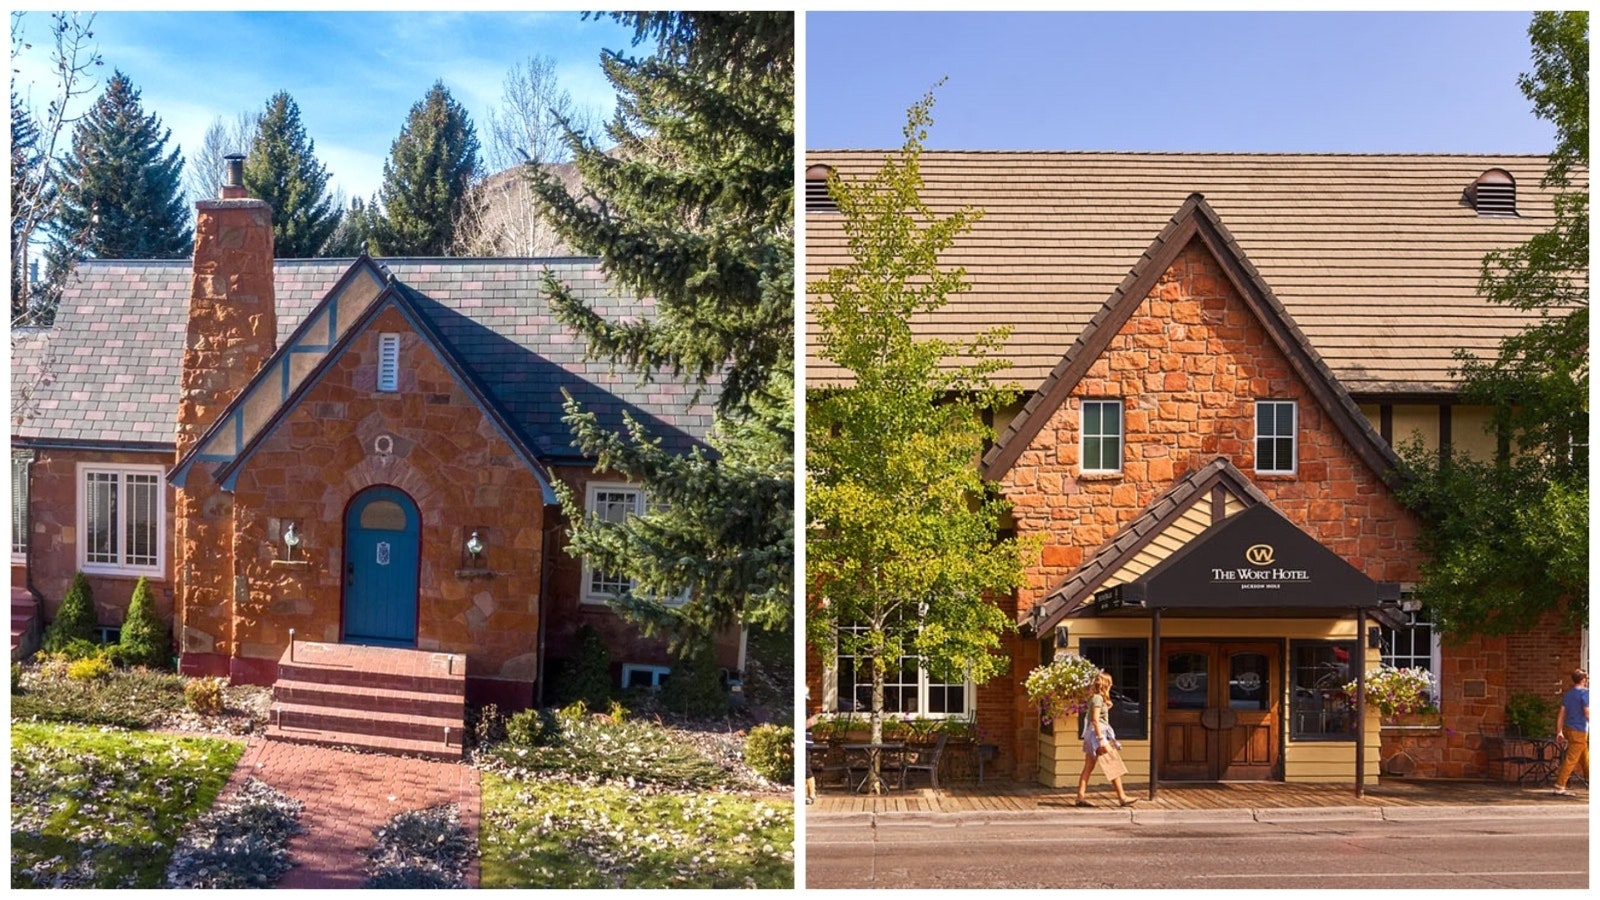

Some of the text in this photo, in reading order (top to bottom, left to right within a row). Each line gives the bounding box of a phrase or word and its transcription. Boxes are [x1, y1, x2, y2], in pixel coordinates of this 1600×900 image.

[1212, 568, 1310, 580] THE WORT HOTEL
